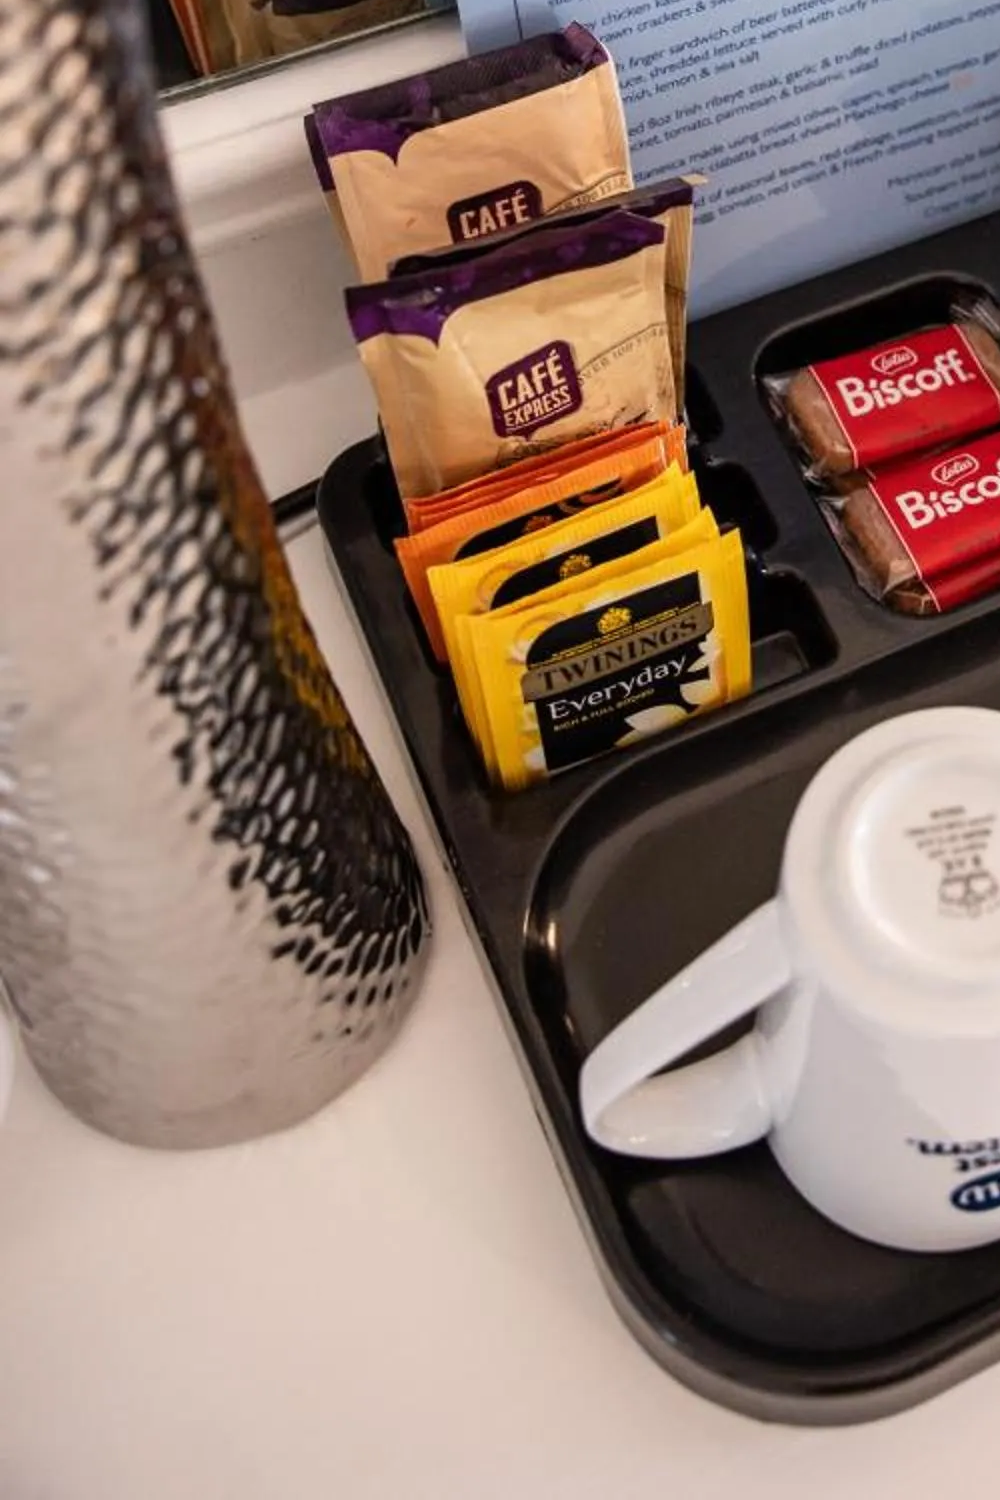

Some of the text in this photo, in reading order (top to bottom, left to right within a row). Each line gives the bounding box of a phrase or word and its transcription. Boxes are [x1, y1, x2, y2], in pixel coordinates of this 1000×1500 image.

[460, 188, 530, 240] CAFÉ
[497, 349, 568, 410] CAFÉ
[504, 386, 572, 427] EXPRESS
[539, 614, 699, 691] TWININGS
[547, 655, 688, 721] Everyday
